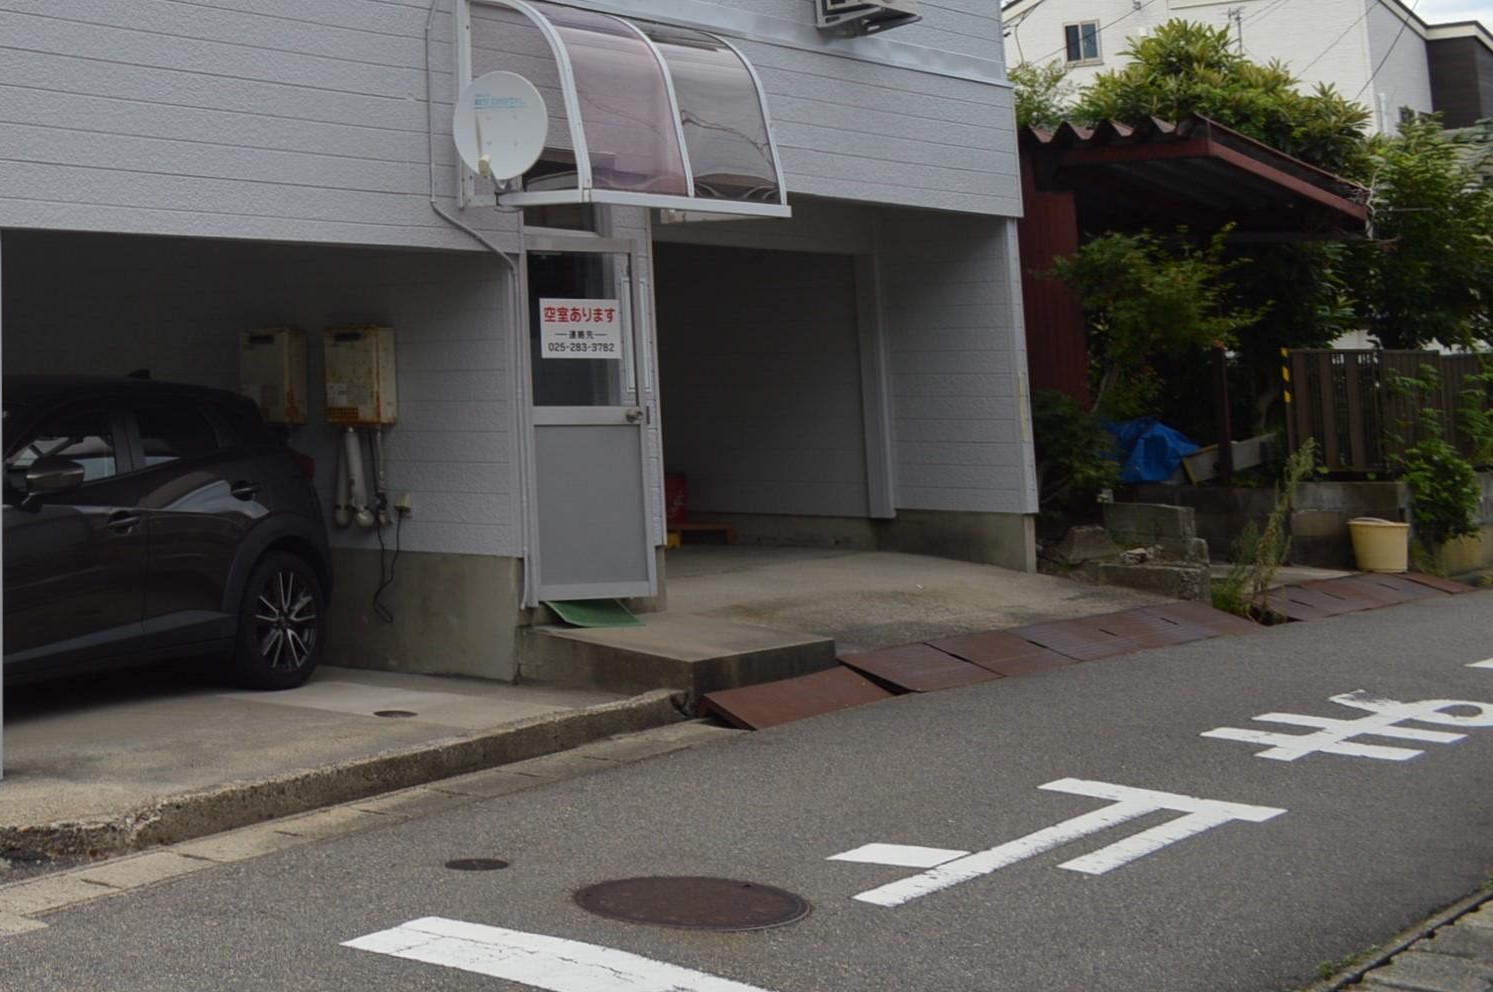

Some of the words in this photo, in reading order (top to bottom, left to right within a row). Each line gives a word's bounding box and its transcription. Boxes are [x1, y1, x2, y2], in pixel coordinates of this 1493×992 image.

[544, 307, 616, 323] 空室あります
[548, 342, 615, 352] 025-283-3782
